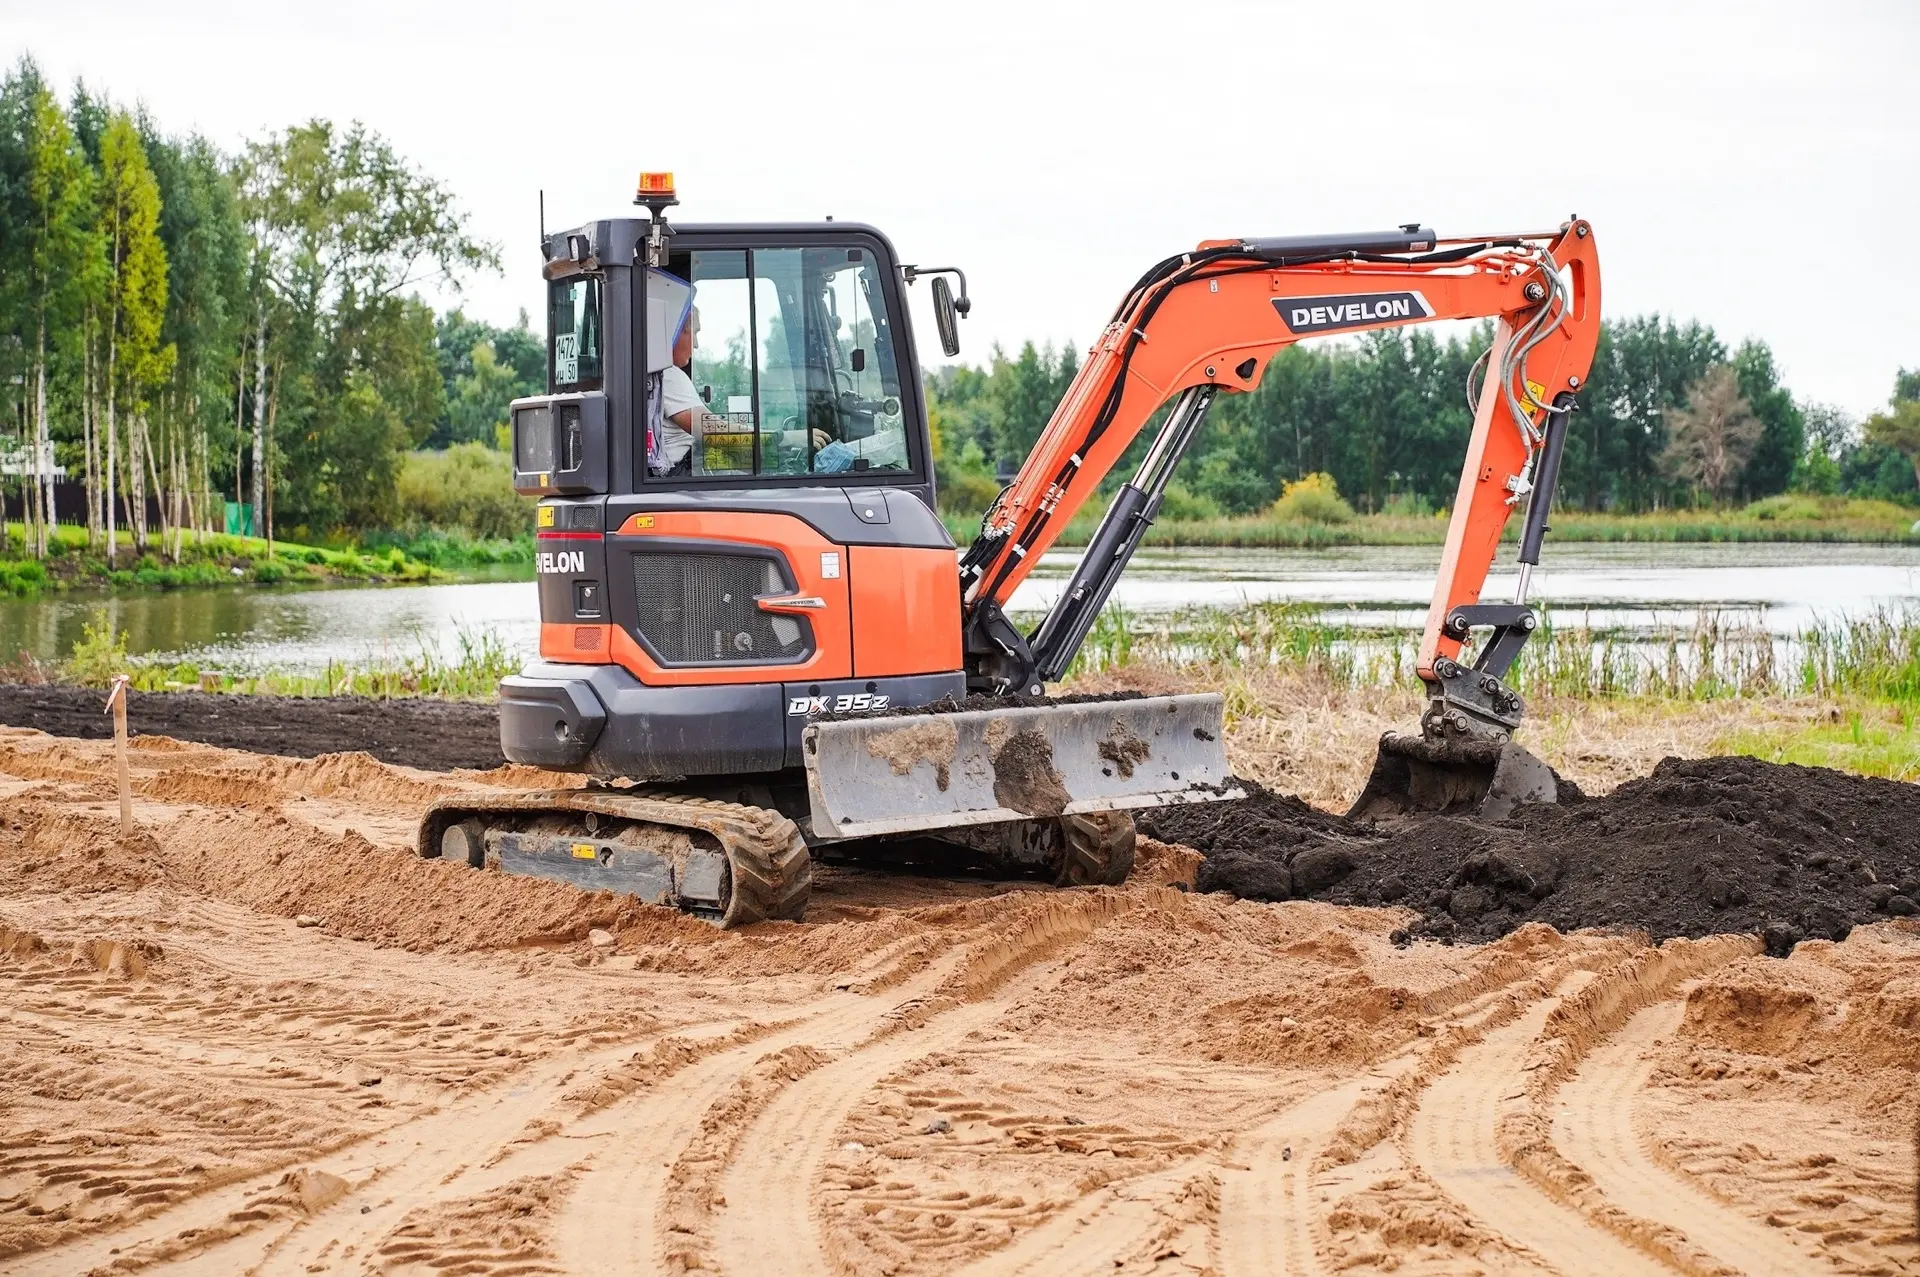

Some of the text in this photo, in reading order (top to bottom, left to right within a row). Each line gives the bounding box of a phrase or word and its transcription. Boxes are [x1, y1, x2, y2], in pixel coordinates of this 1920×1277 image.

[1291, 298, 1410, 327] DEVELON
[556, 336, 575, 360] 1472
[568, 363, 576, 380] 50
[788, 695, 831, 716] DX
